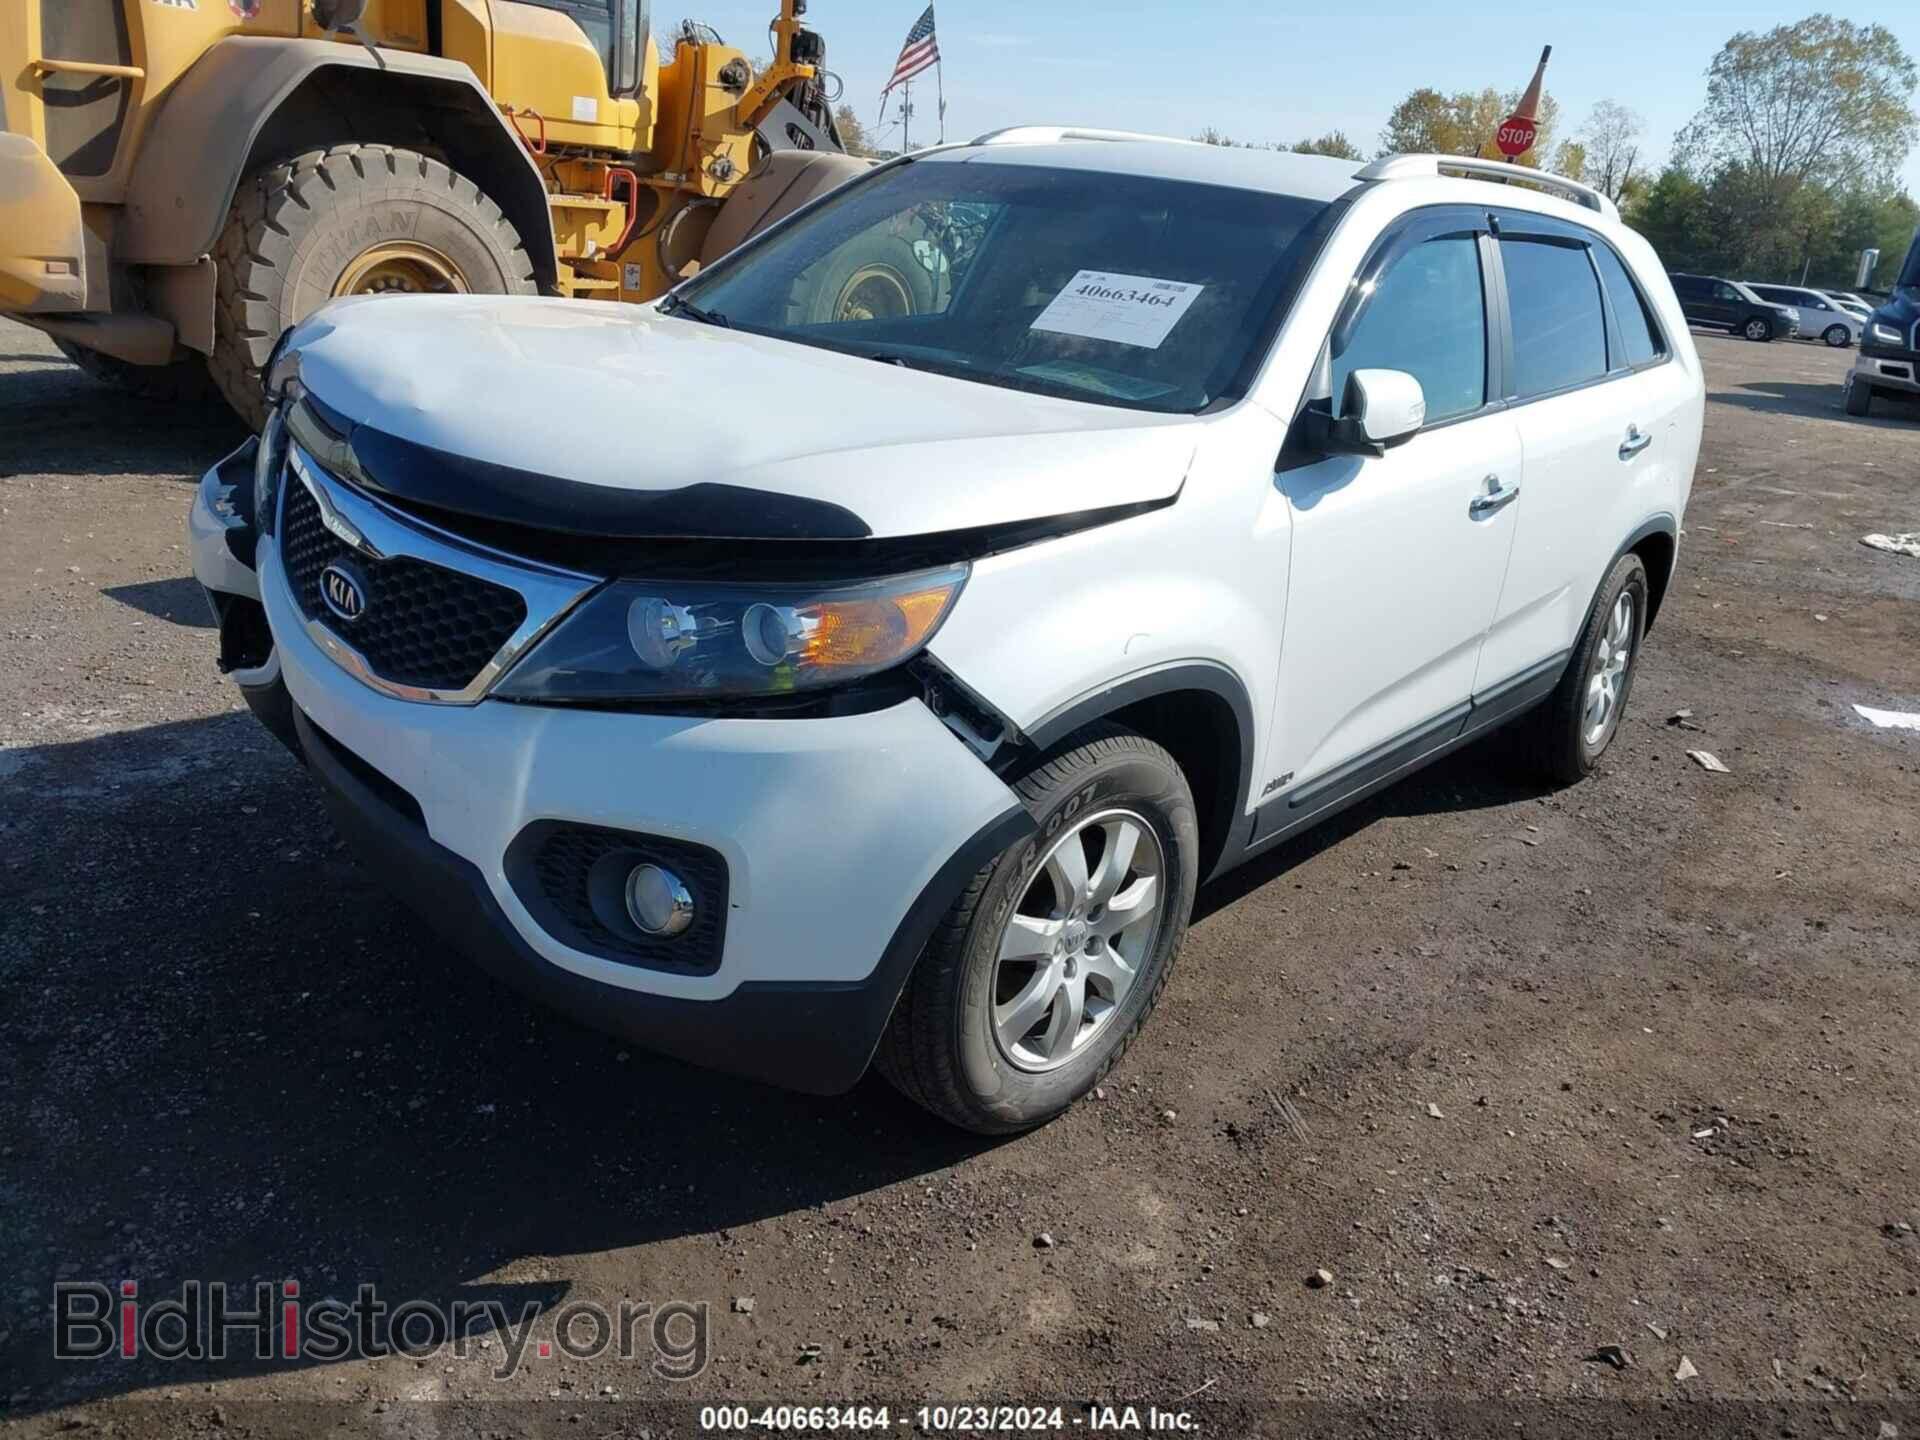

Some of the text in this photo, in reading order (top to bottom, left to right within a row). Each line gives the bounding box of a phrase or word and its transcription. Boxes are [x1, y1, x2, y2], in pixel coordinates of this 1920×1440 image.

[1498, 127, 1534, 145] STOP
[310, 210, 418, 280] TITAN
[1075, 284, 1176, 307] 40663464
[329, 573, 356, 613] KIA
[1045, 782, 1098, 837] 007
